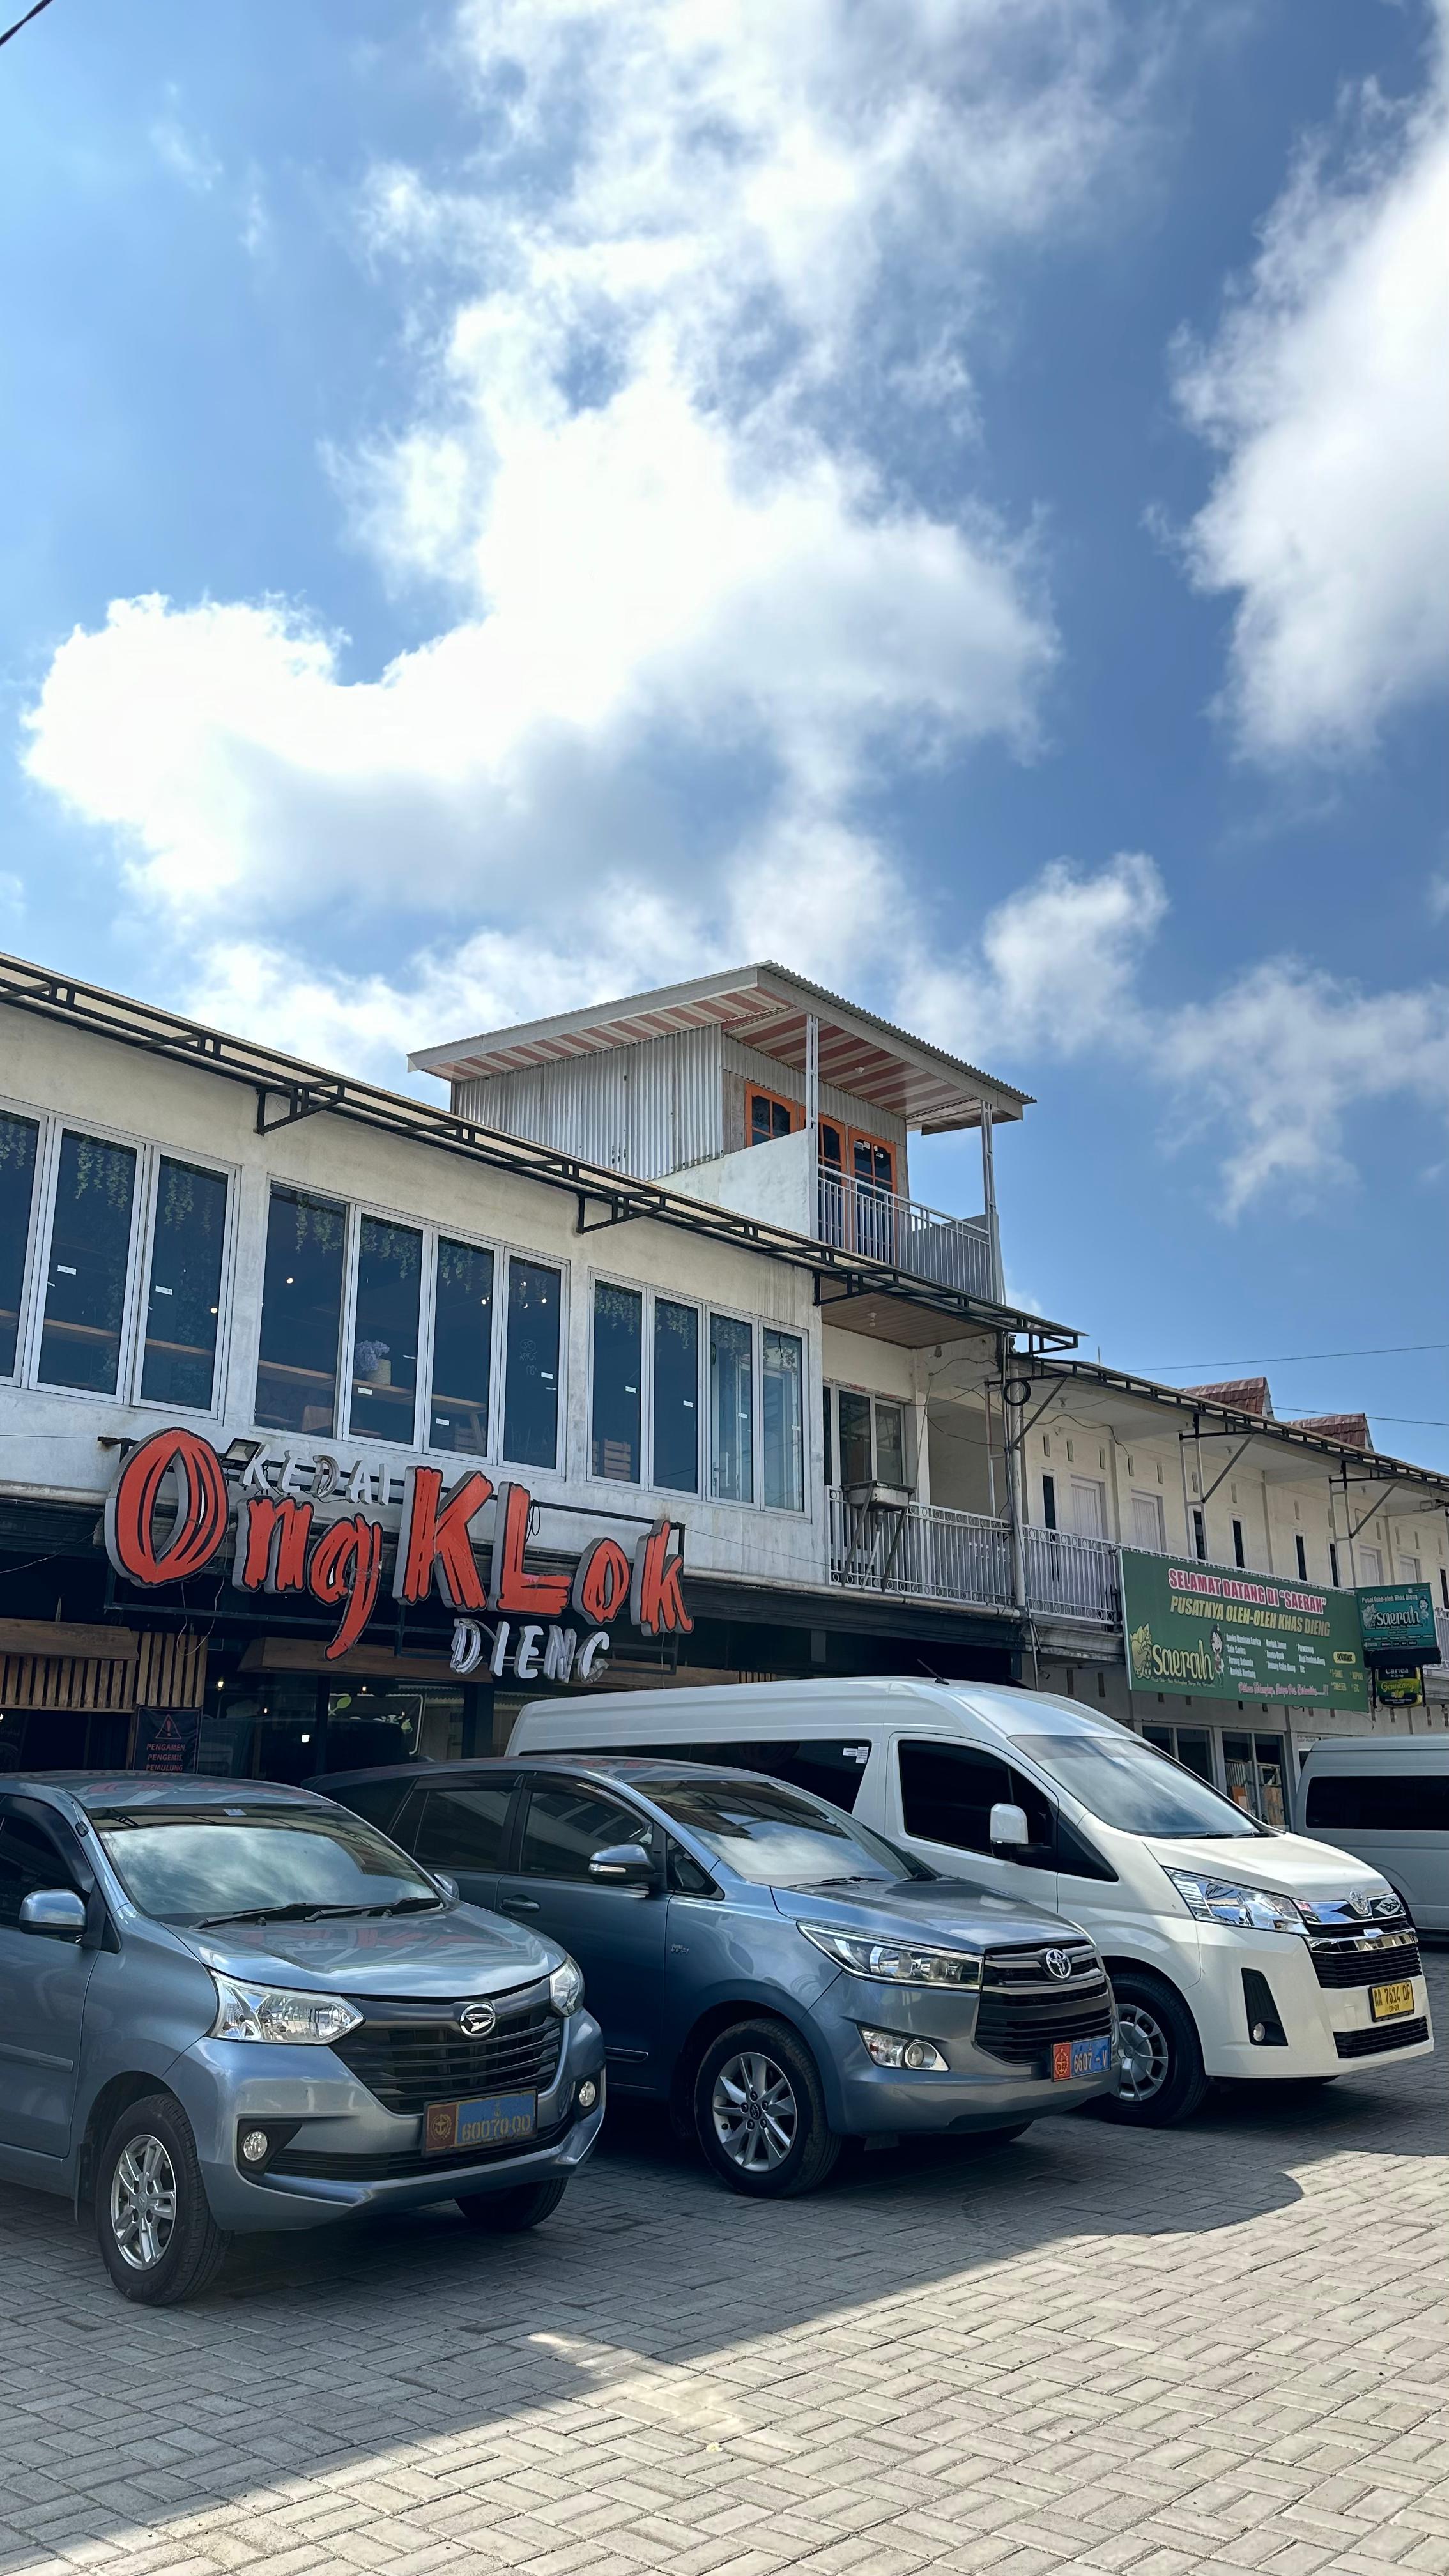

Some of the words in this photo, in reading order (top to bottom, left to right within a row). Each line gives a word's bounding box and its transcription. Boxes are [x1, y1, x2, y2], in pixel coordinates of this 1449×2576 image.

[238, 1443, 391, 1505] KEDAI
[1169, 1568, 1221, 1597] SELAMAT
[1222, 1579, 1266, 1605] DATANG
[1266, 1587, 1279, 1607] DI
[1170, 1596, 1223, 1621] PUSATNYA
[1226, 1606, 1276, 1629] OLEH-OLEH
[1278, 1614, 1303, 1633] KHAS
[1305, 1618, 1330, 1637] DIENG
[1374, 1989, 1383, 2007] AA
